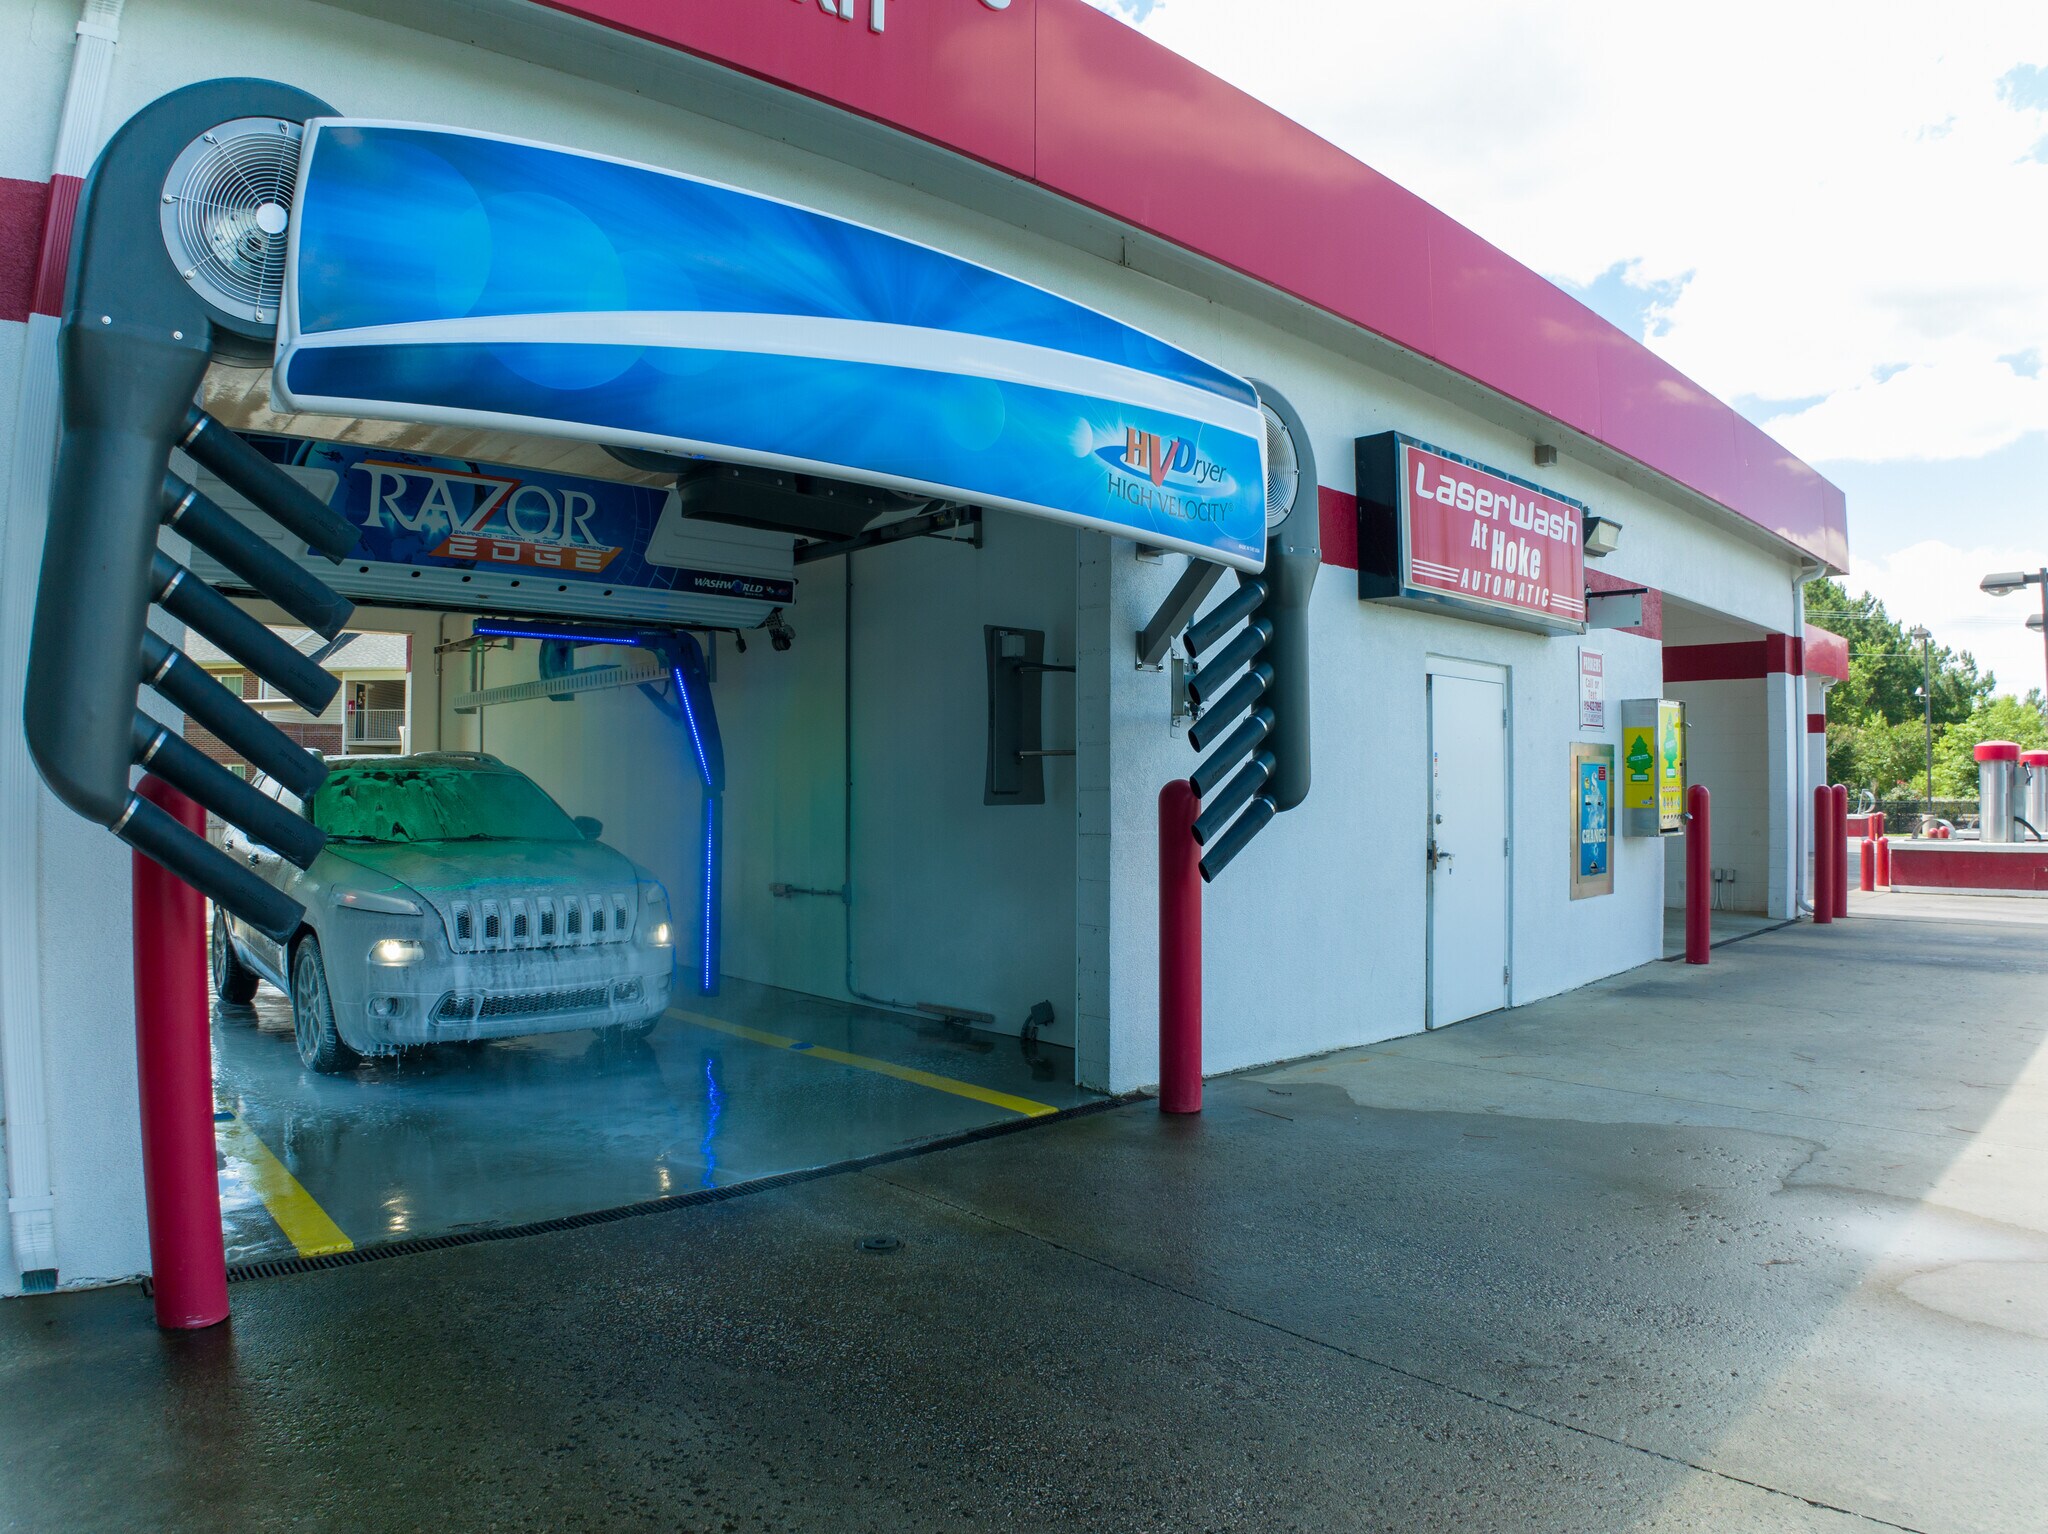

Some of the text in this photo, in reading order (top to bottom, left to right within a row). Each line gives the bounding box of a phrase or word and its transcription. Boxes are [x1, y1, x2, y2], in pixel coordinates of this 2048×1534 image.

[350, 462, 606, 548] RAZOR
[1108, 473, 1152, 510] HIGH
[448, 536, 602, 570] EDGE
[1471, 519, 1541, 580] At Hoke
[1460, 568, 1549, 607] AUTOMATIC
[1582, 828, 1607, 844] CHANGE
